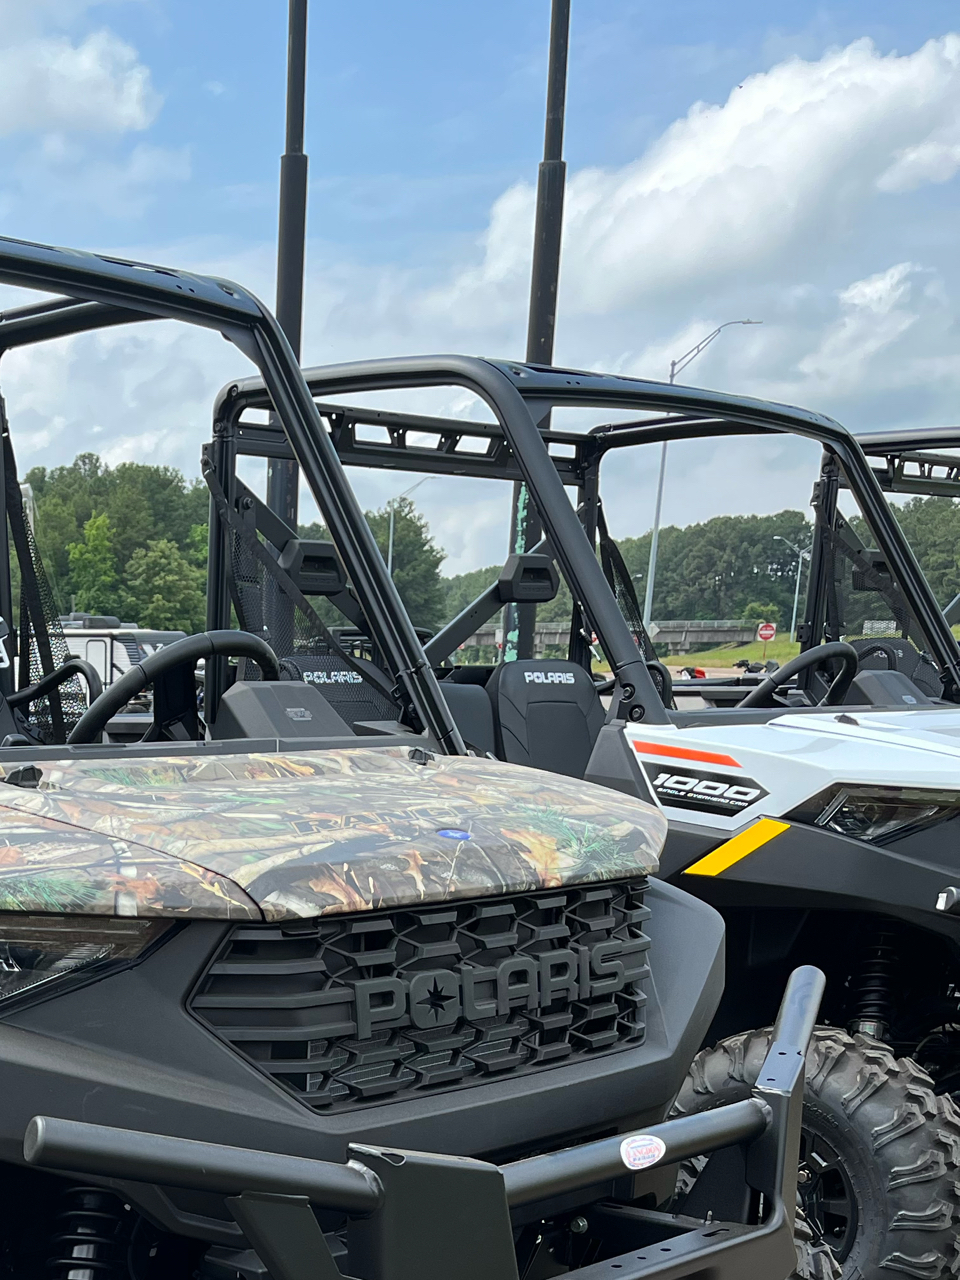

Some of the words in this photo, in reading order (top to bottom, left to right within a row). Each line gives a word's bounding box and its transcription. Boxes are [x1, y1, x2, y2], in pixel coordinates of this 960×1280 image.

[302, 671, 363, 684] POLARIS
[524, 671, 575, 684] POLARIS
[652, 773, 761, 801] 1000
[656, 787, 686, 796] SINGLE
[289, 802, 522, 837] RANGER
[354, 938, 626, 1041] POLARIS
